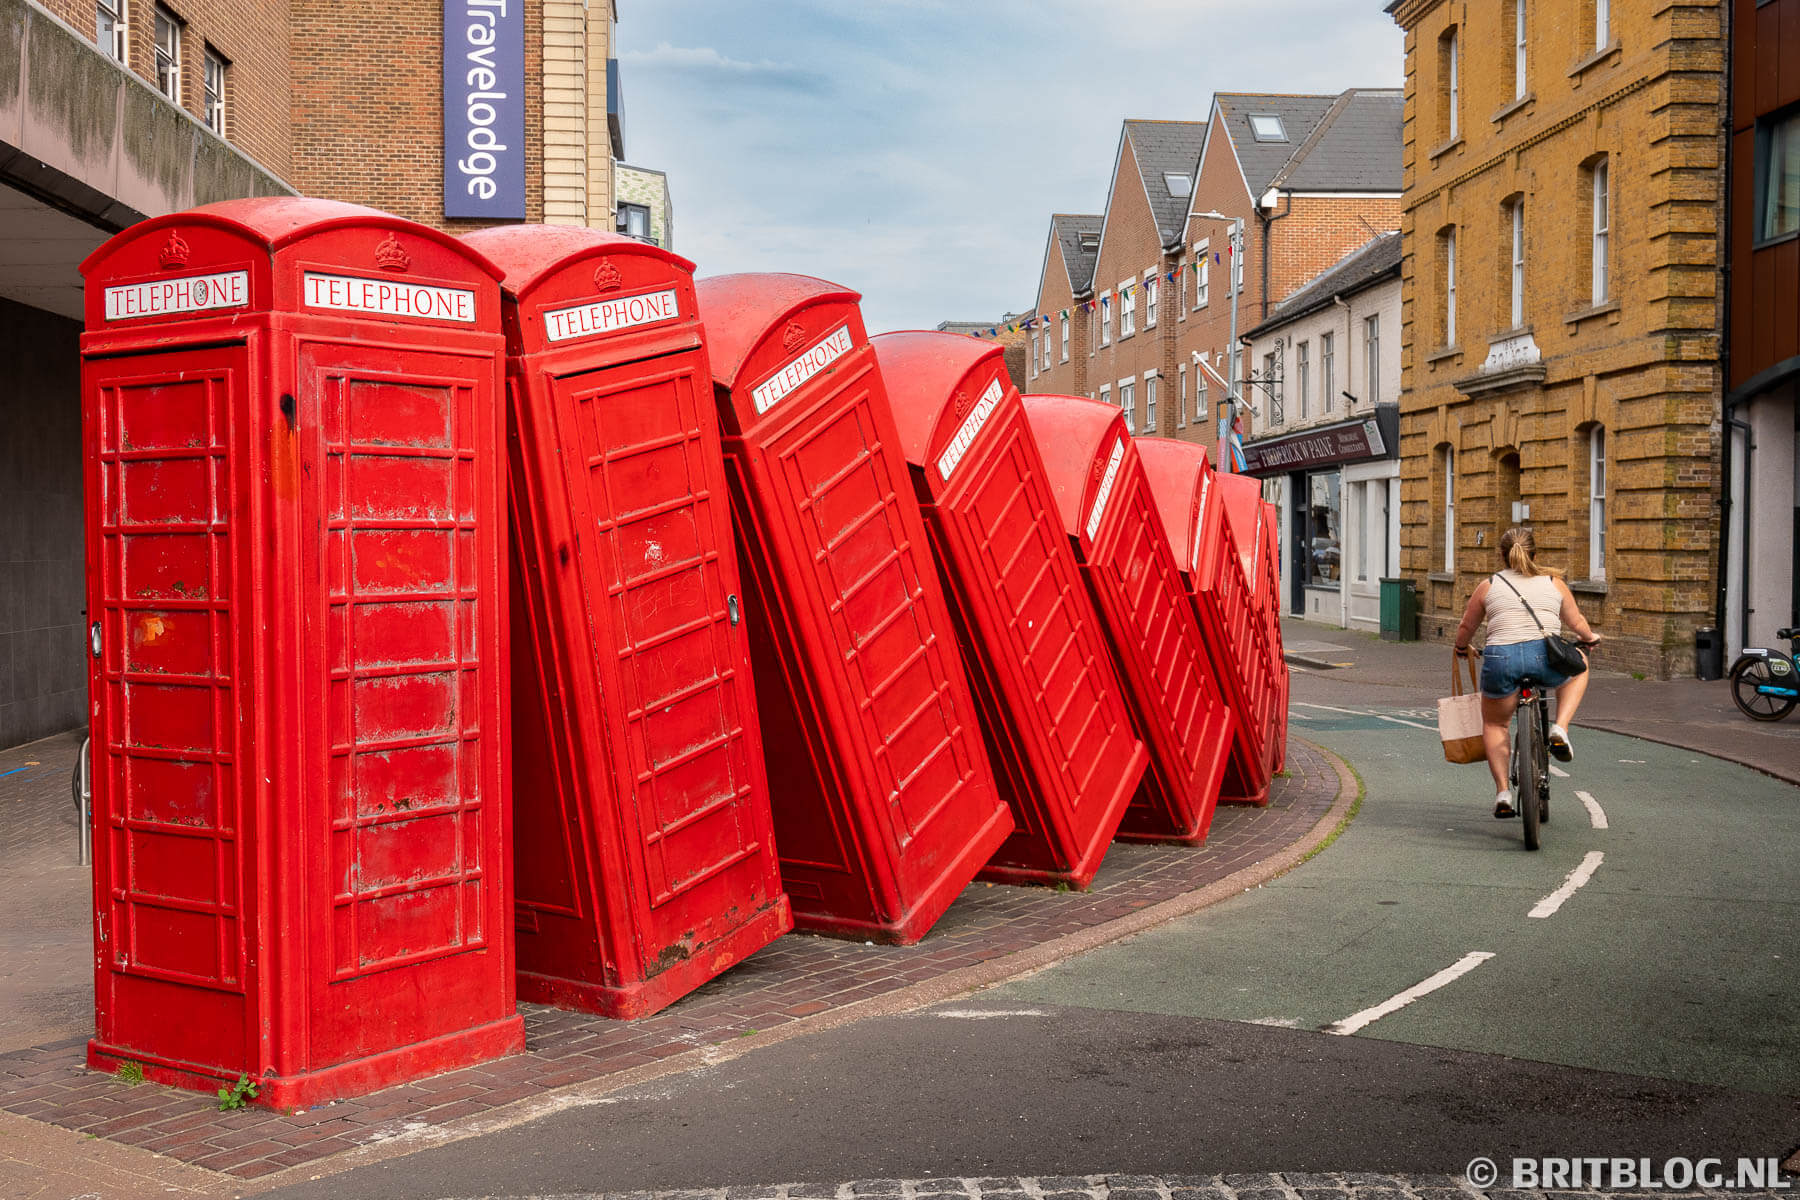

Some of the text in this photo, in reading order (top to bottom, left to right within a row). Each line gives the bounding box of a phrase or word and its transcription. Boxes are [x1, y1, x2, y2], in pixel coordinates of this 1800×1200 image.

[458, 0, 507, 200] Travelodge
[112, 276, 242, 316] TELEPHONE
[308, 277, 468, 318] TELEPHONE
[551, 294, 673, 337] TELEPHONE
[757, 331, 848, 407] TELEPHONE
[942, 383, 1001, 473] TELEPHONE
[1260, 442, 1303, 467] FREDERICK
[1299, 440, 1311, 460] W
[1309, 436, 1336, 459] PAINE
